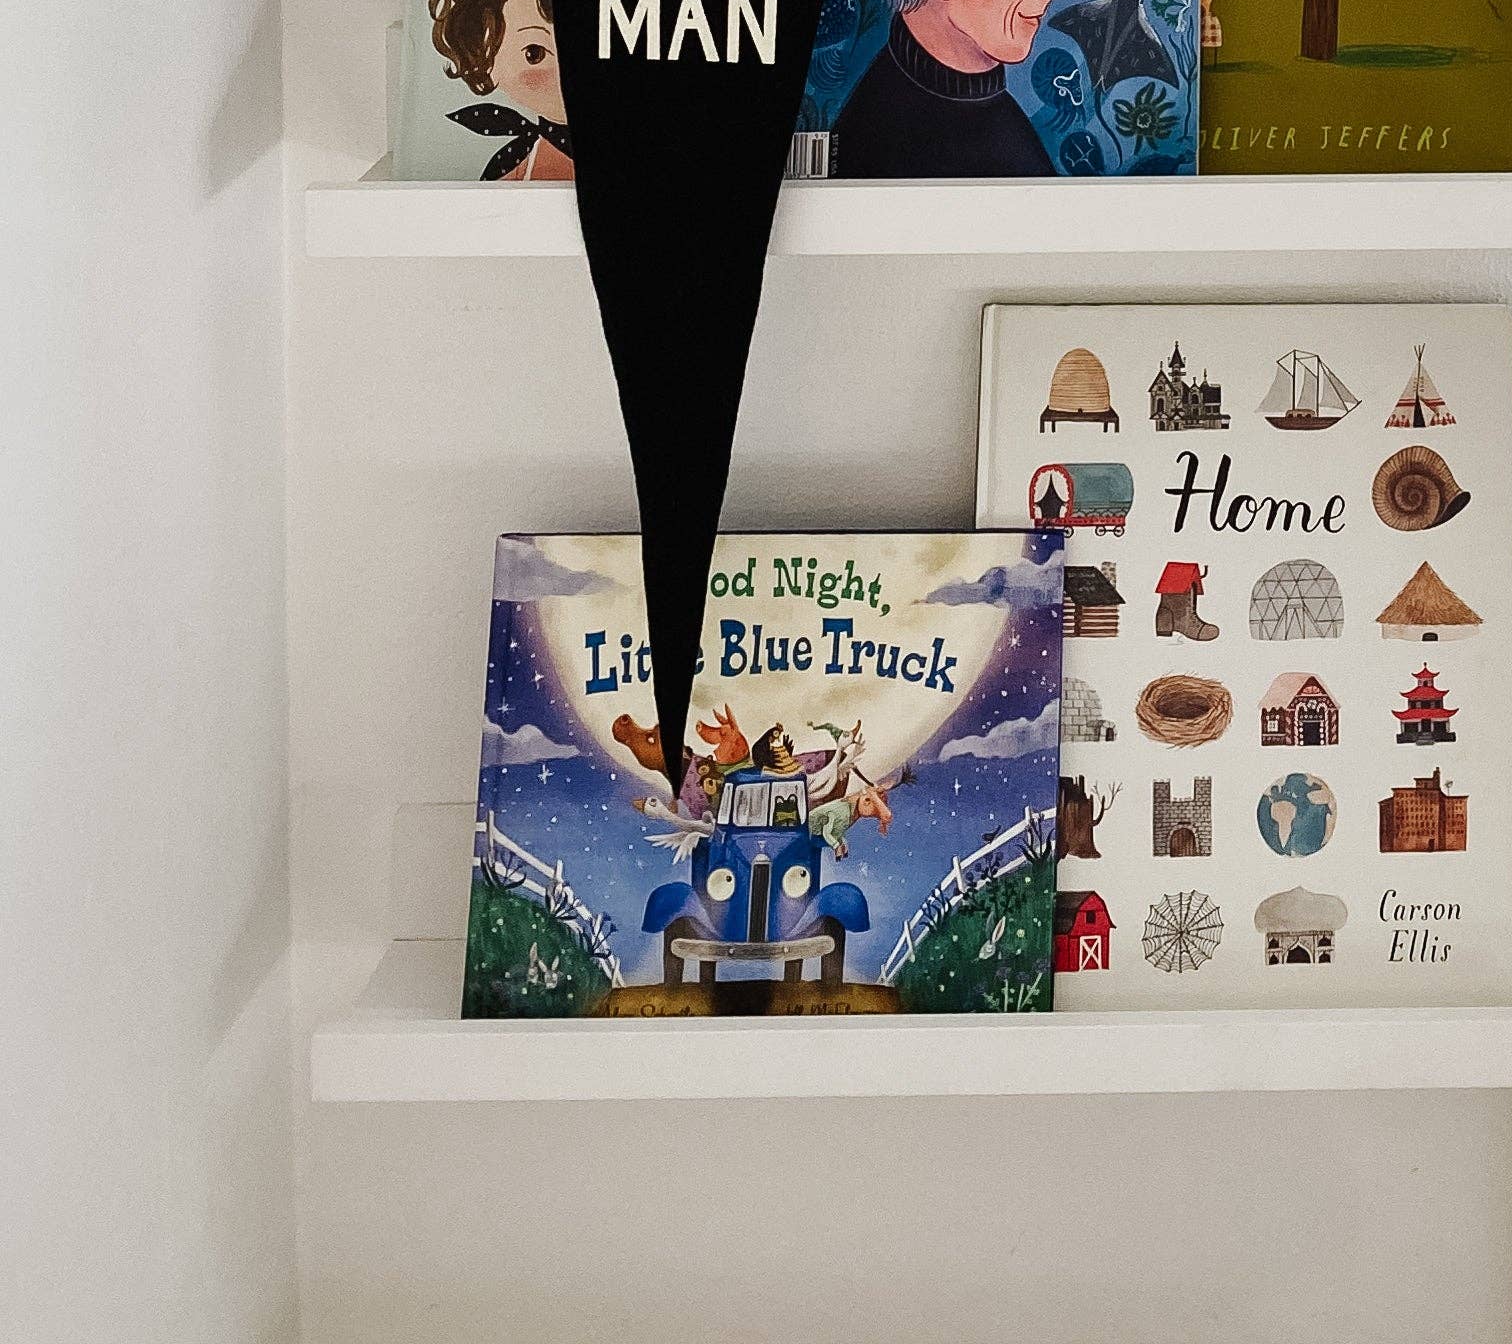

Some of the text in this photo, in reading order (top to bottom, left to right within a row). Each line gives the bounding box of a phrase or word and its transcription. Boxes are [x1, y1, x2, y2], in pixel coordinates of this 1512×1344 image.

[1320, 125, 1451, 151] JEFFERS
[1165, 451, 1347, 534] Home
[711, 557, 891, 617] od Night,
[720, 618, 812, 677] Blue
[821, 617, 958, 693] Truck
[1380, 889, 1461, 922] Carson
[1388, 929, 1451, 963] Ellis
